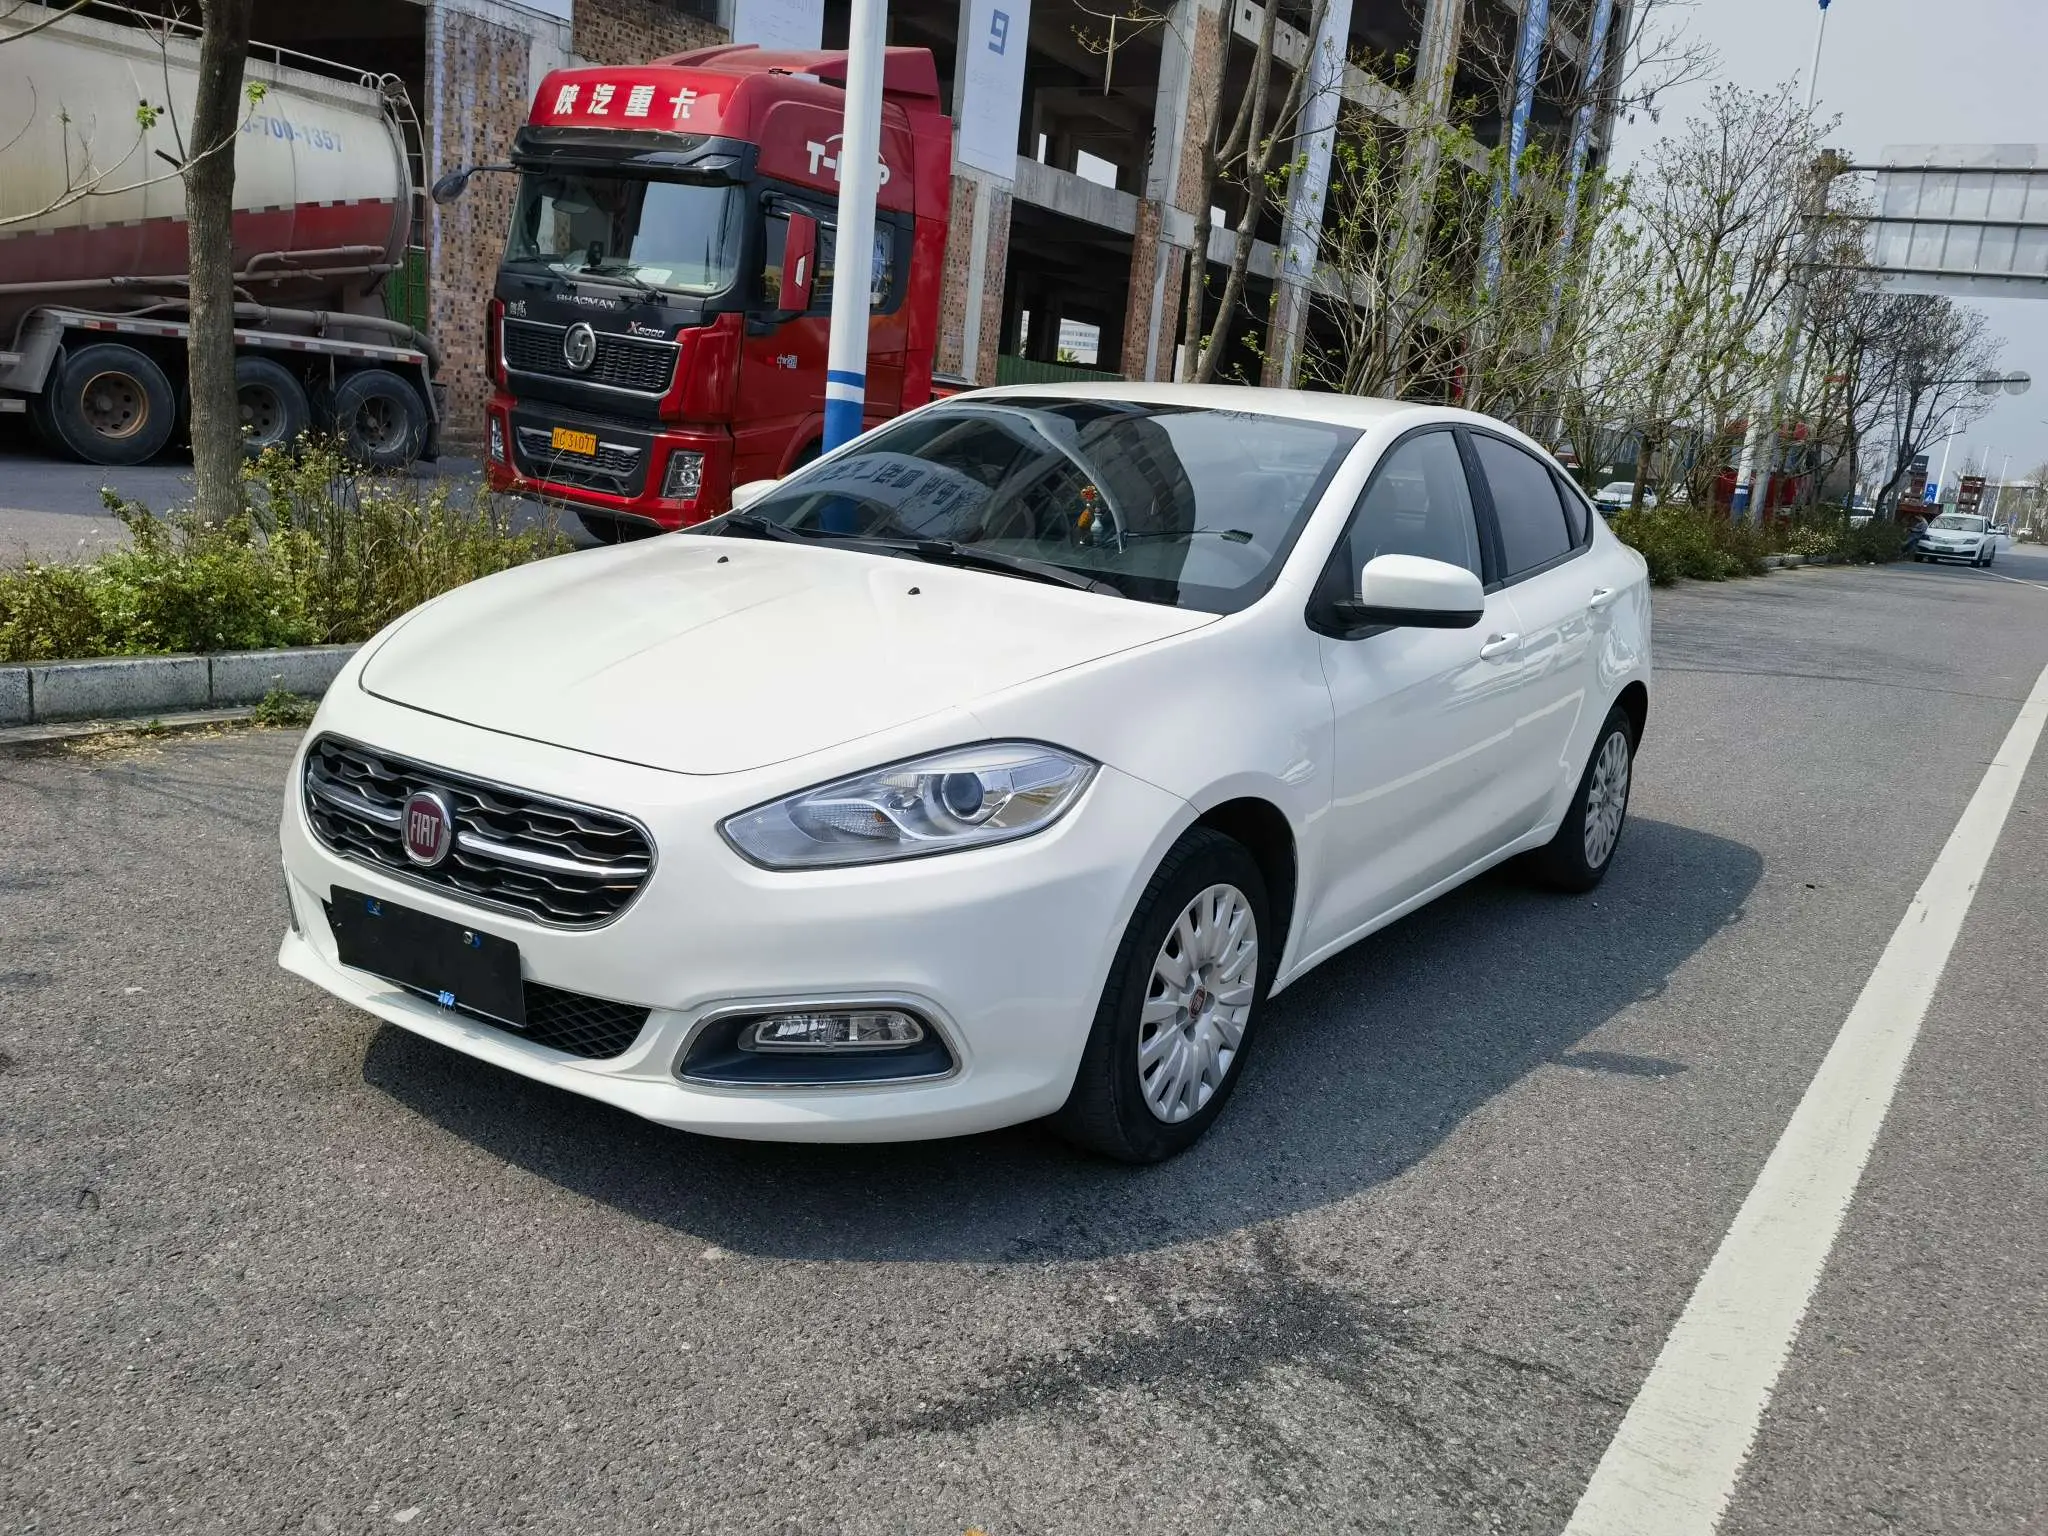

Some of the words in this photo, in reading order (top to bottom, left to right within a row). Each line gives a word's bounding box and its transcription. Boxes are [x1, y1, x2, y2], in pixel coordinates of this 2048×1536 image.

[553, 83, 698, 119] 陕汽重卡
[410, 810, 440, 848] FIAT
